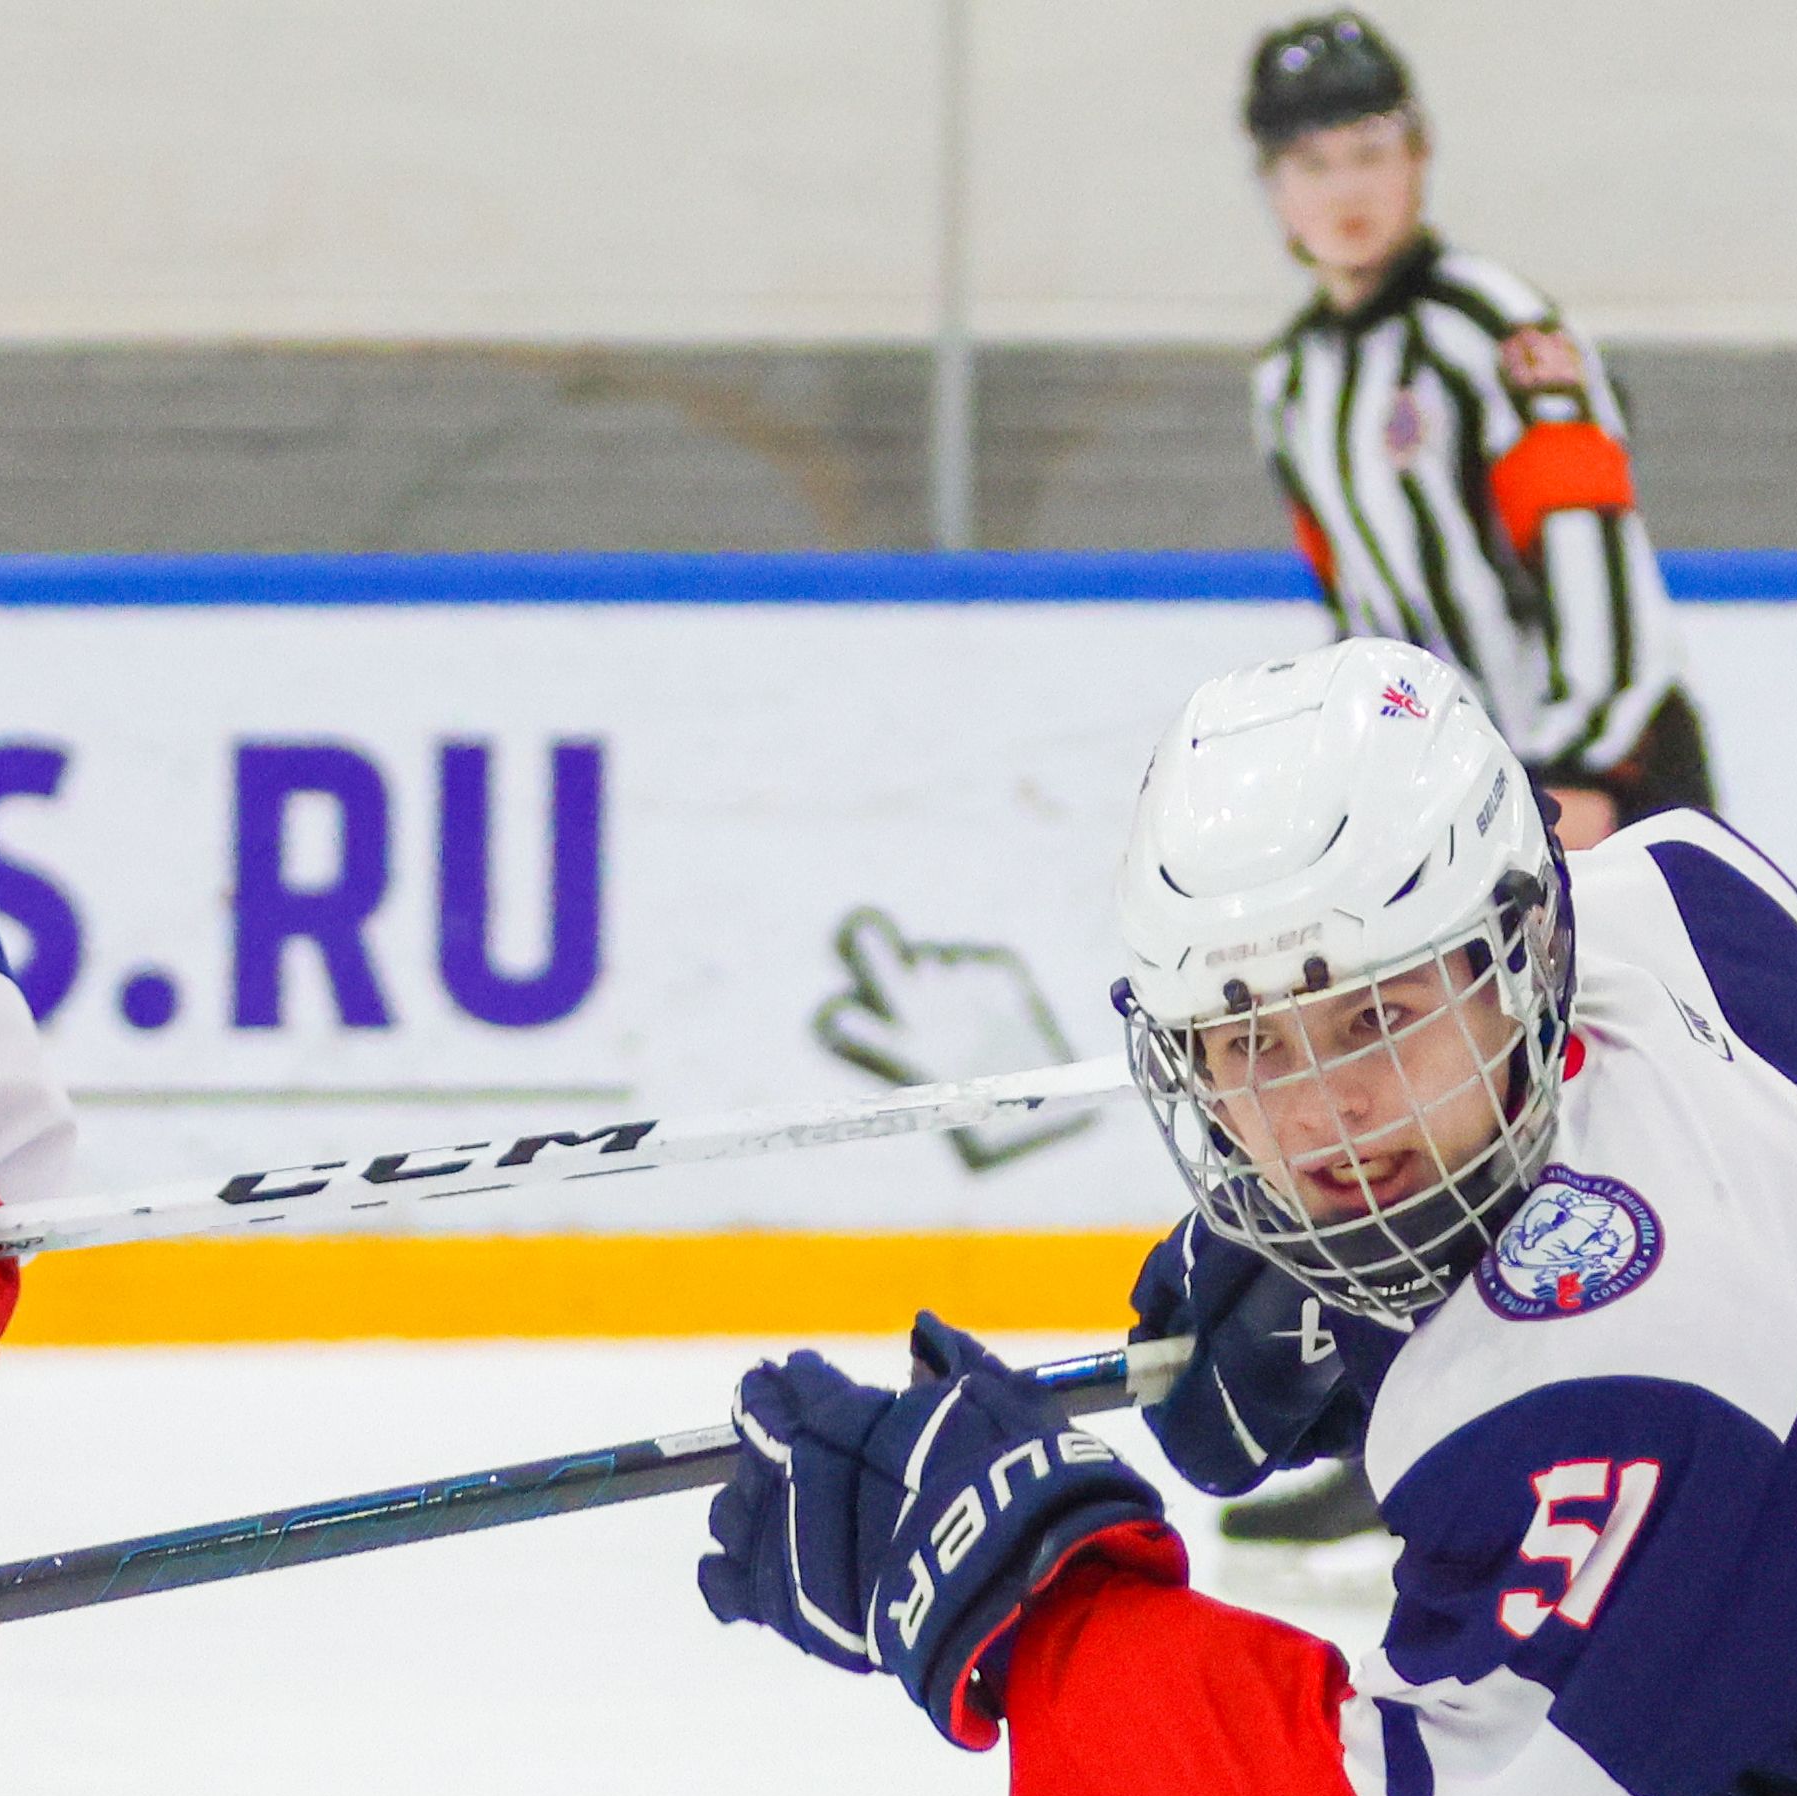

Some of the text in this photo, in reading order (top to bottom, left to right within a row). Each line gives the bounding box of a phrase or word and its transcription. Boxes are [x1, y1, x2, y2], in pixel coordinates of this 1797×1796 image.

[216, 1119, 661, 1205] CCM
[887, 1431, 1116, 1651] AUER
[1497, 1457, 1663, 1640] 51
